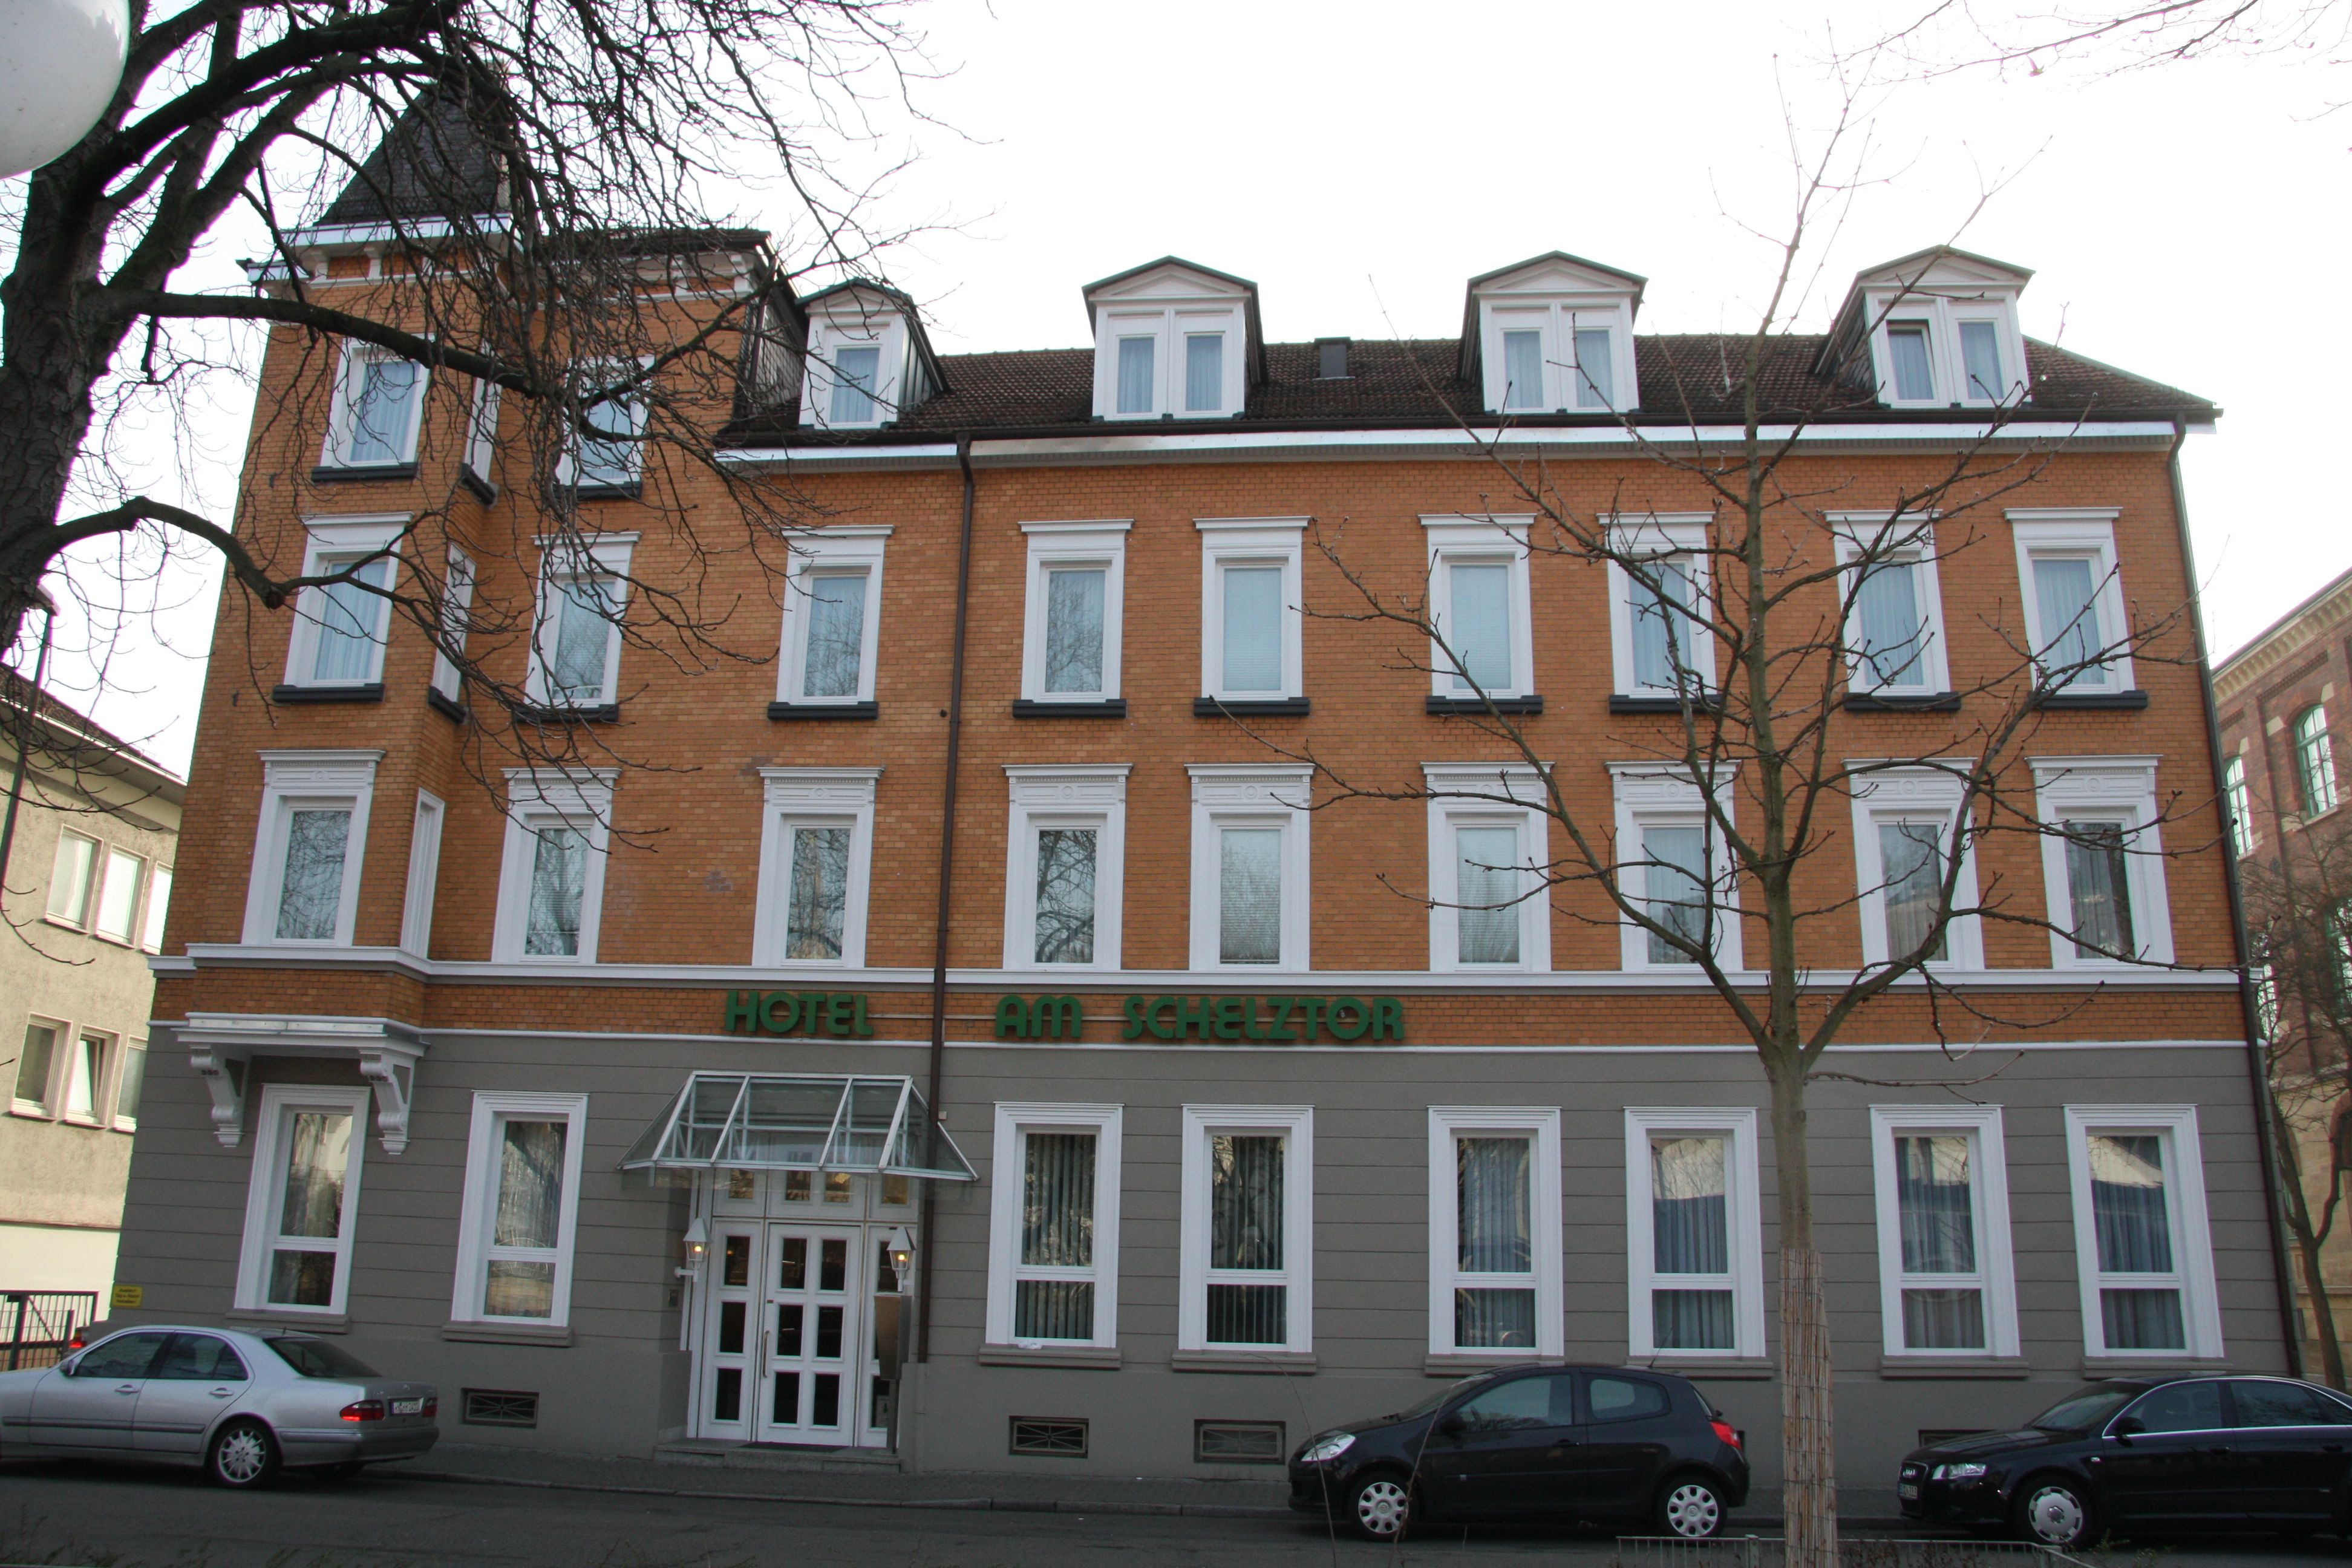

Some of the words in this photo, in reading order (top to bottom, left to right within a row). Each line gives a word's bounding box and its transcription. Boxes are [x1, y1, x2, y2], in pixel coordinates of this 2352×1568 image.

[725, 990, 874, 1035] HOTEL
[995, 995, 1082, 1038] AM
[1122, 995, 1405, 1040] SCHELZTOR
